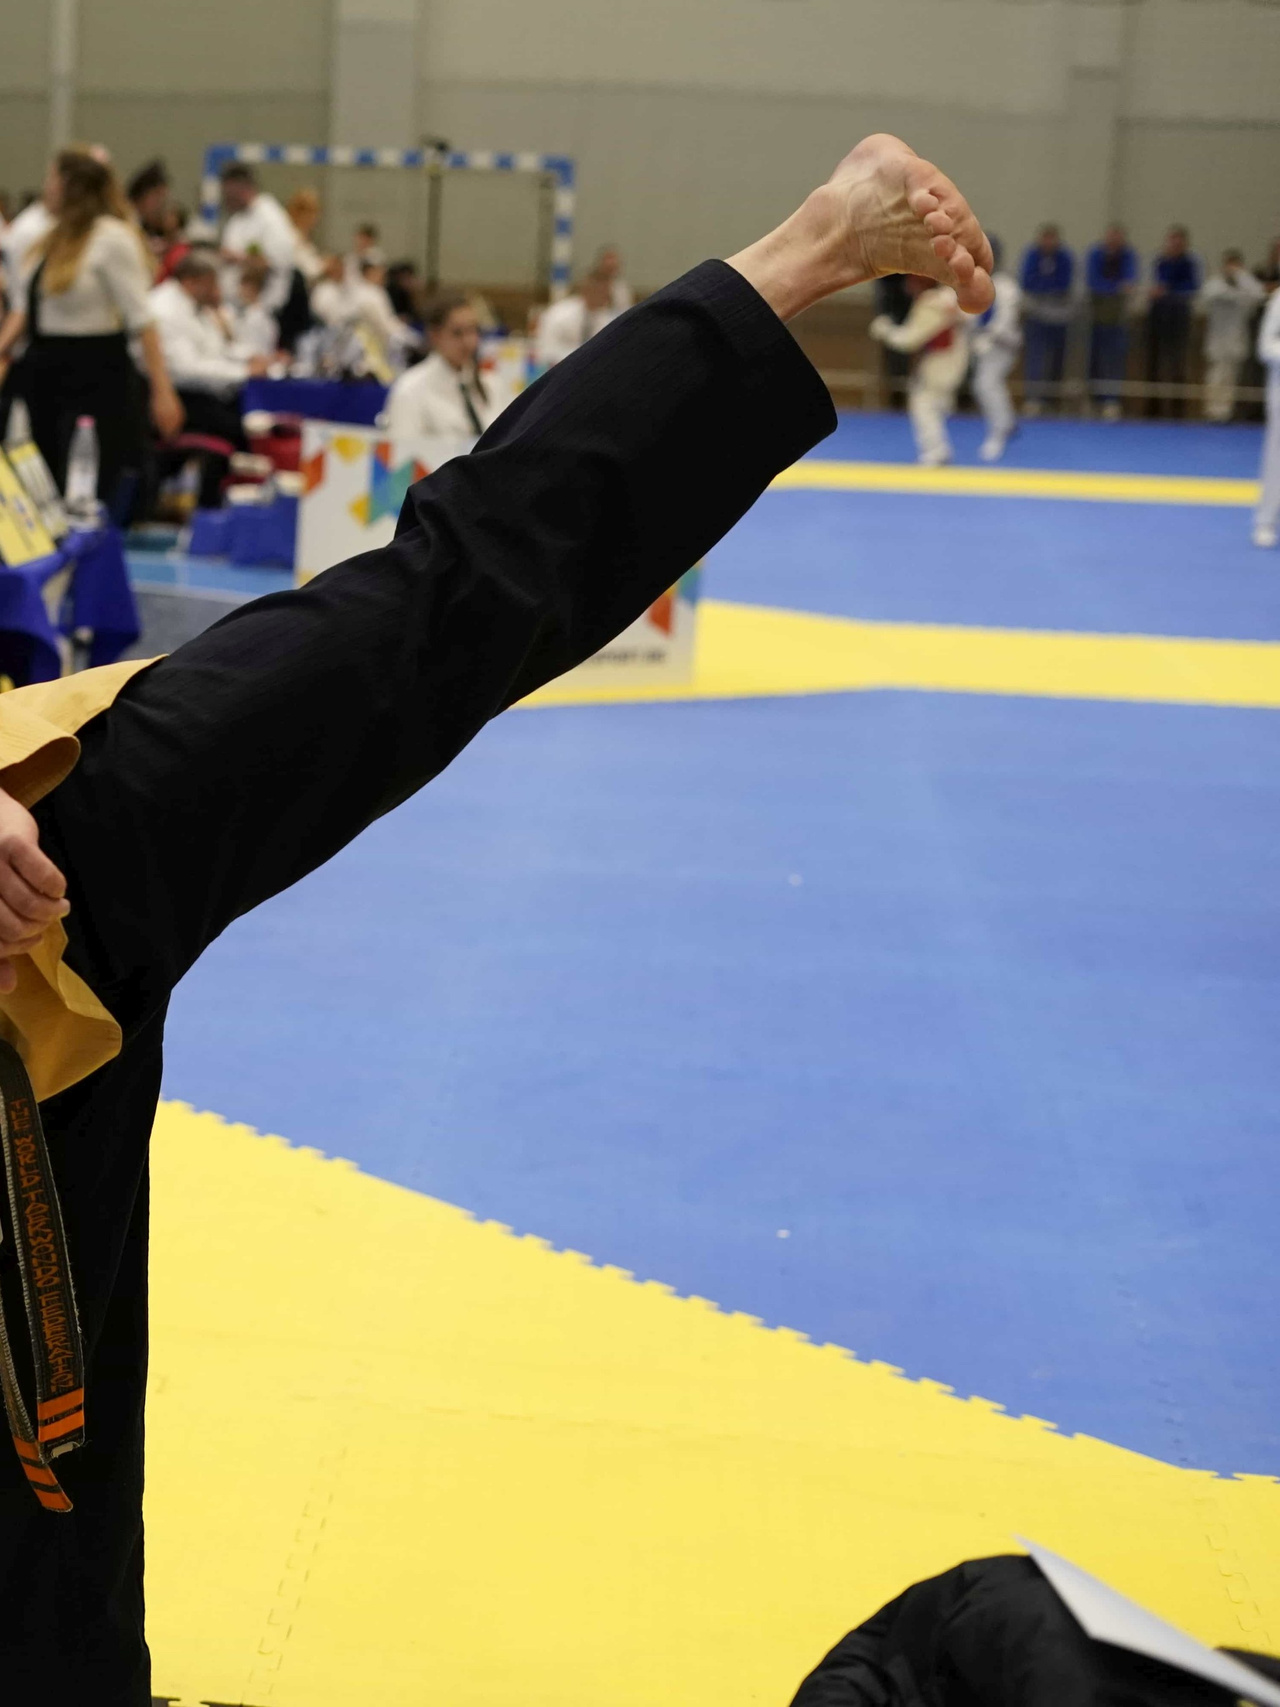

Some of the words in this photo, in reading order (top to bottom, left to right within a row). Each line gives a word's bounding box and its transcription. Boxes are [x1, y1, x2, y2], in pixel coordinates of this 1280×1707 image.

[10, 1098, 31, 1130] THE
[15, 1134, 41, 1188] WORLD
[22, 1189, 60, 1288] TAEKWONDO
[38, 1291, 74, 1392] FEDERATION
